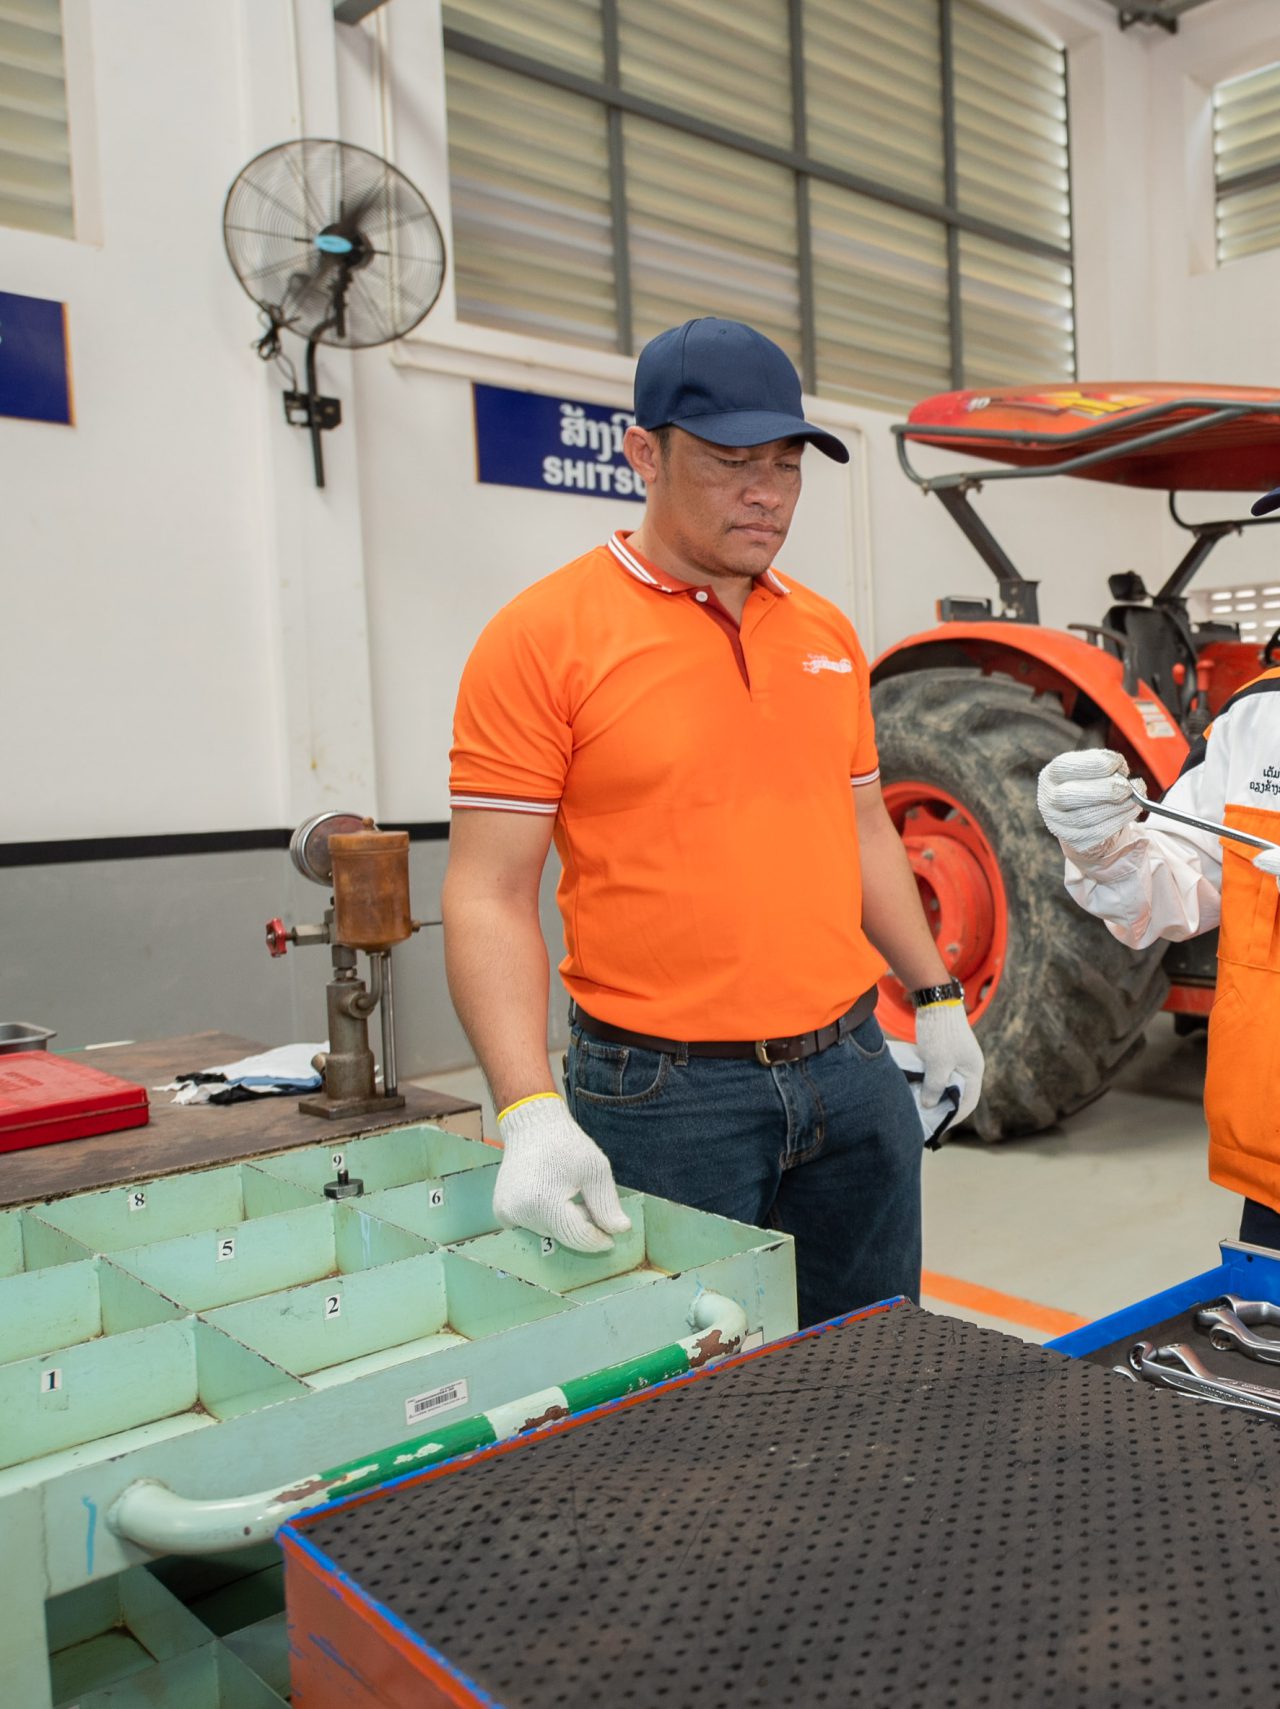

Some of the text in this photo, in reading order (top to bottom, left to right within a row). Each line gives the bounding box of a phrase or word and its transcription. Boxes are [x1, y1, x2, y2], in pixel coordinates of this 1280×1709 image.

[333, 1155, 342, 1166] 9
[134, 1193, 145, 1207] 8
[431, 1192, 441, 1204] 6
[222, 1240, 233, 1256] 5
[543, 1237, 553, 1252] 3
[328, 1296, 339, 1315] 2
[47, 1371, 56, 1390] 1
